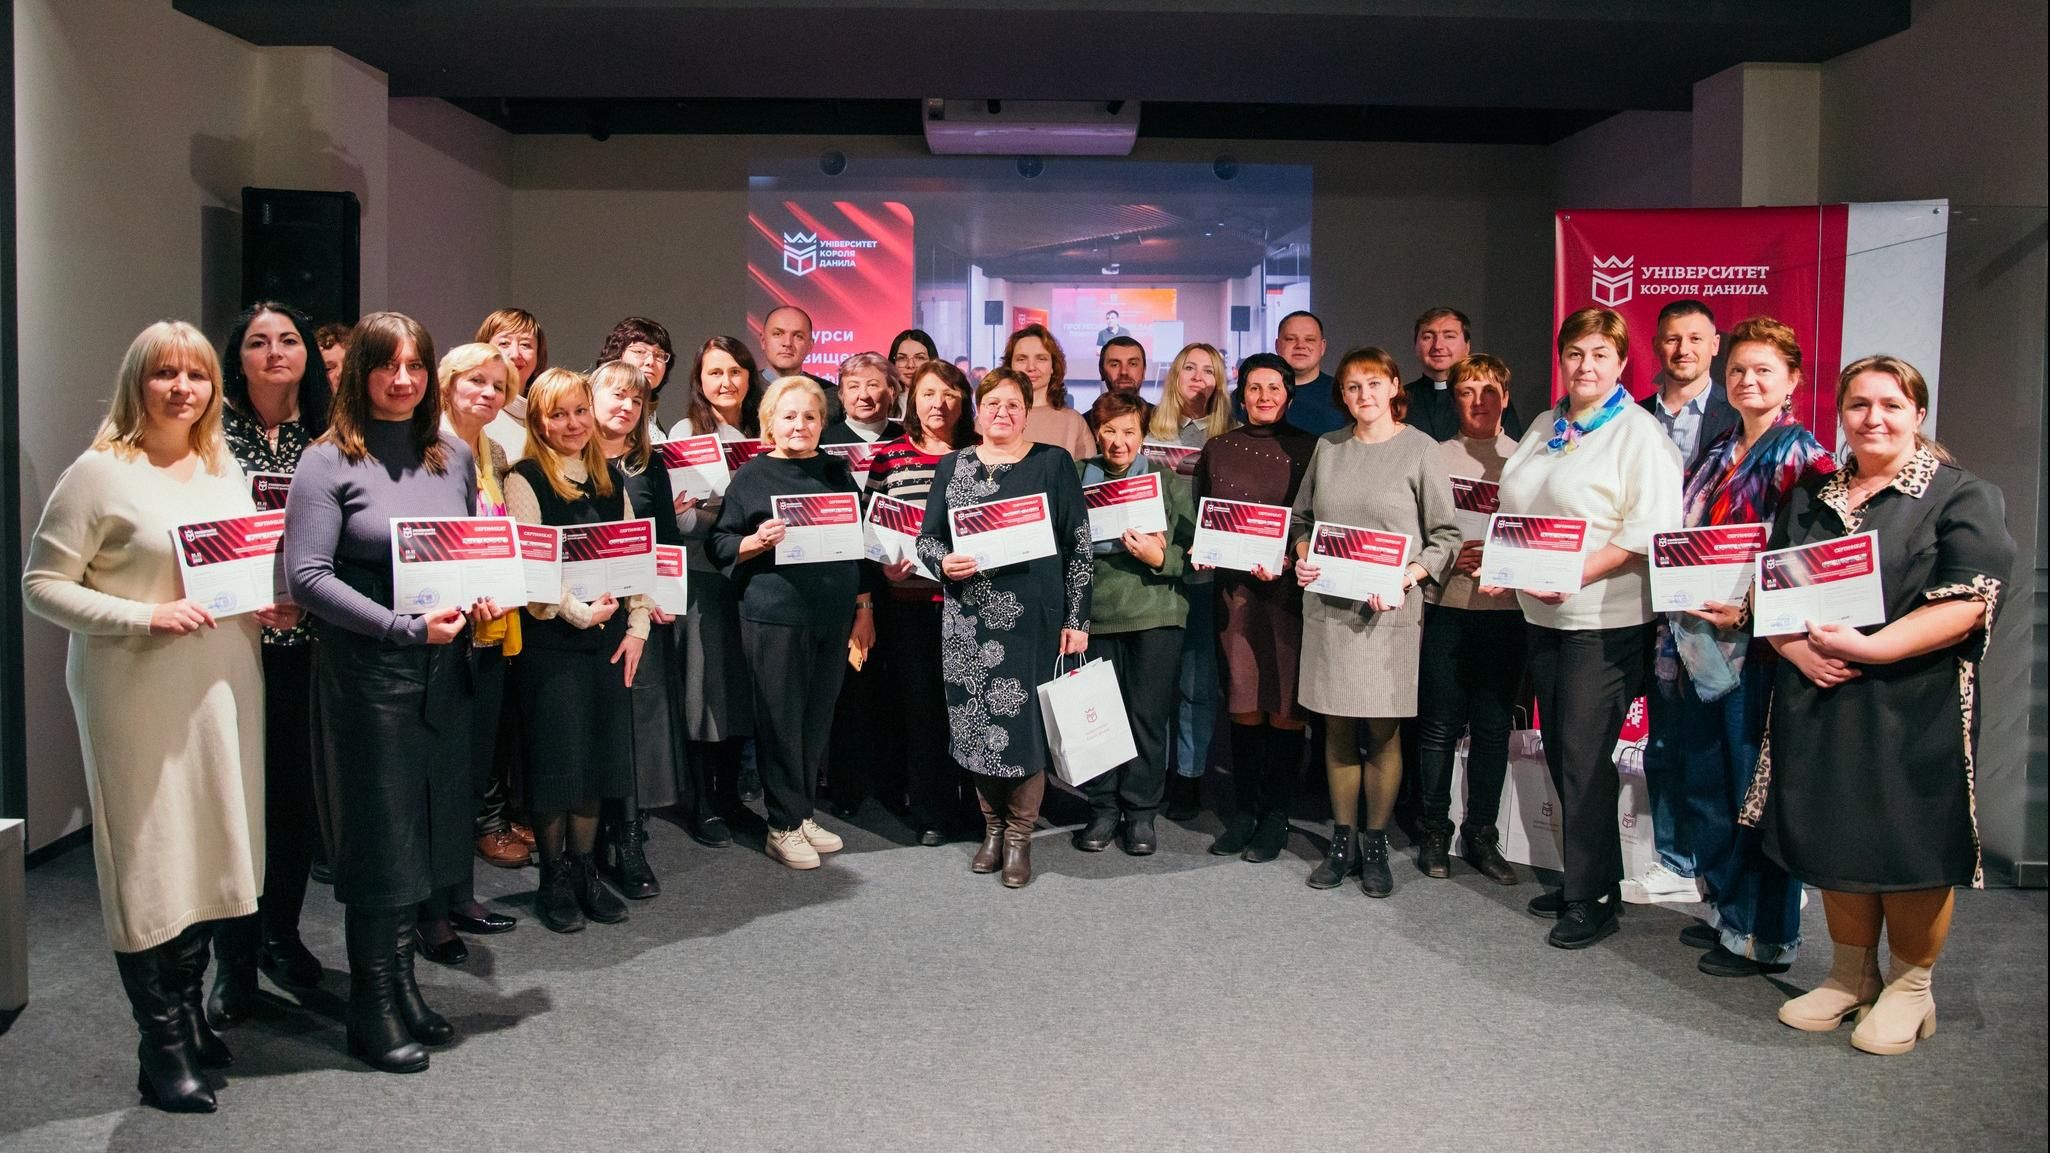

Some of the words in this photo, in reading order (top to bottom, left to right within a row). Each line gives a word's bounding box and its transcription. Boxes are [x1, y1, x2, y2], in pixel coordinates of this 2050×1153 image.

[820, 240, 877, 248] УНІВЕРСИТЕТ
[819, 260, 856, 268] ДАНИЛА
[1641, 266, 1770, 279] УНІВЕРСИТЕТ
[1640, 284, 1699, 295] КОРОЛЯ
[1702, 284, 1769, 297] ДАНИЛА
[811, 330, 854, 344] урси
